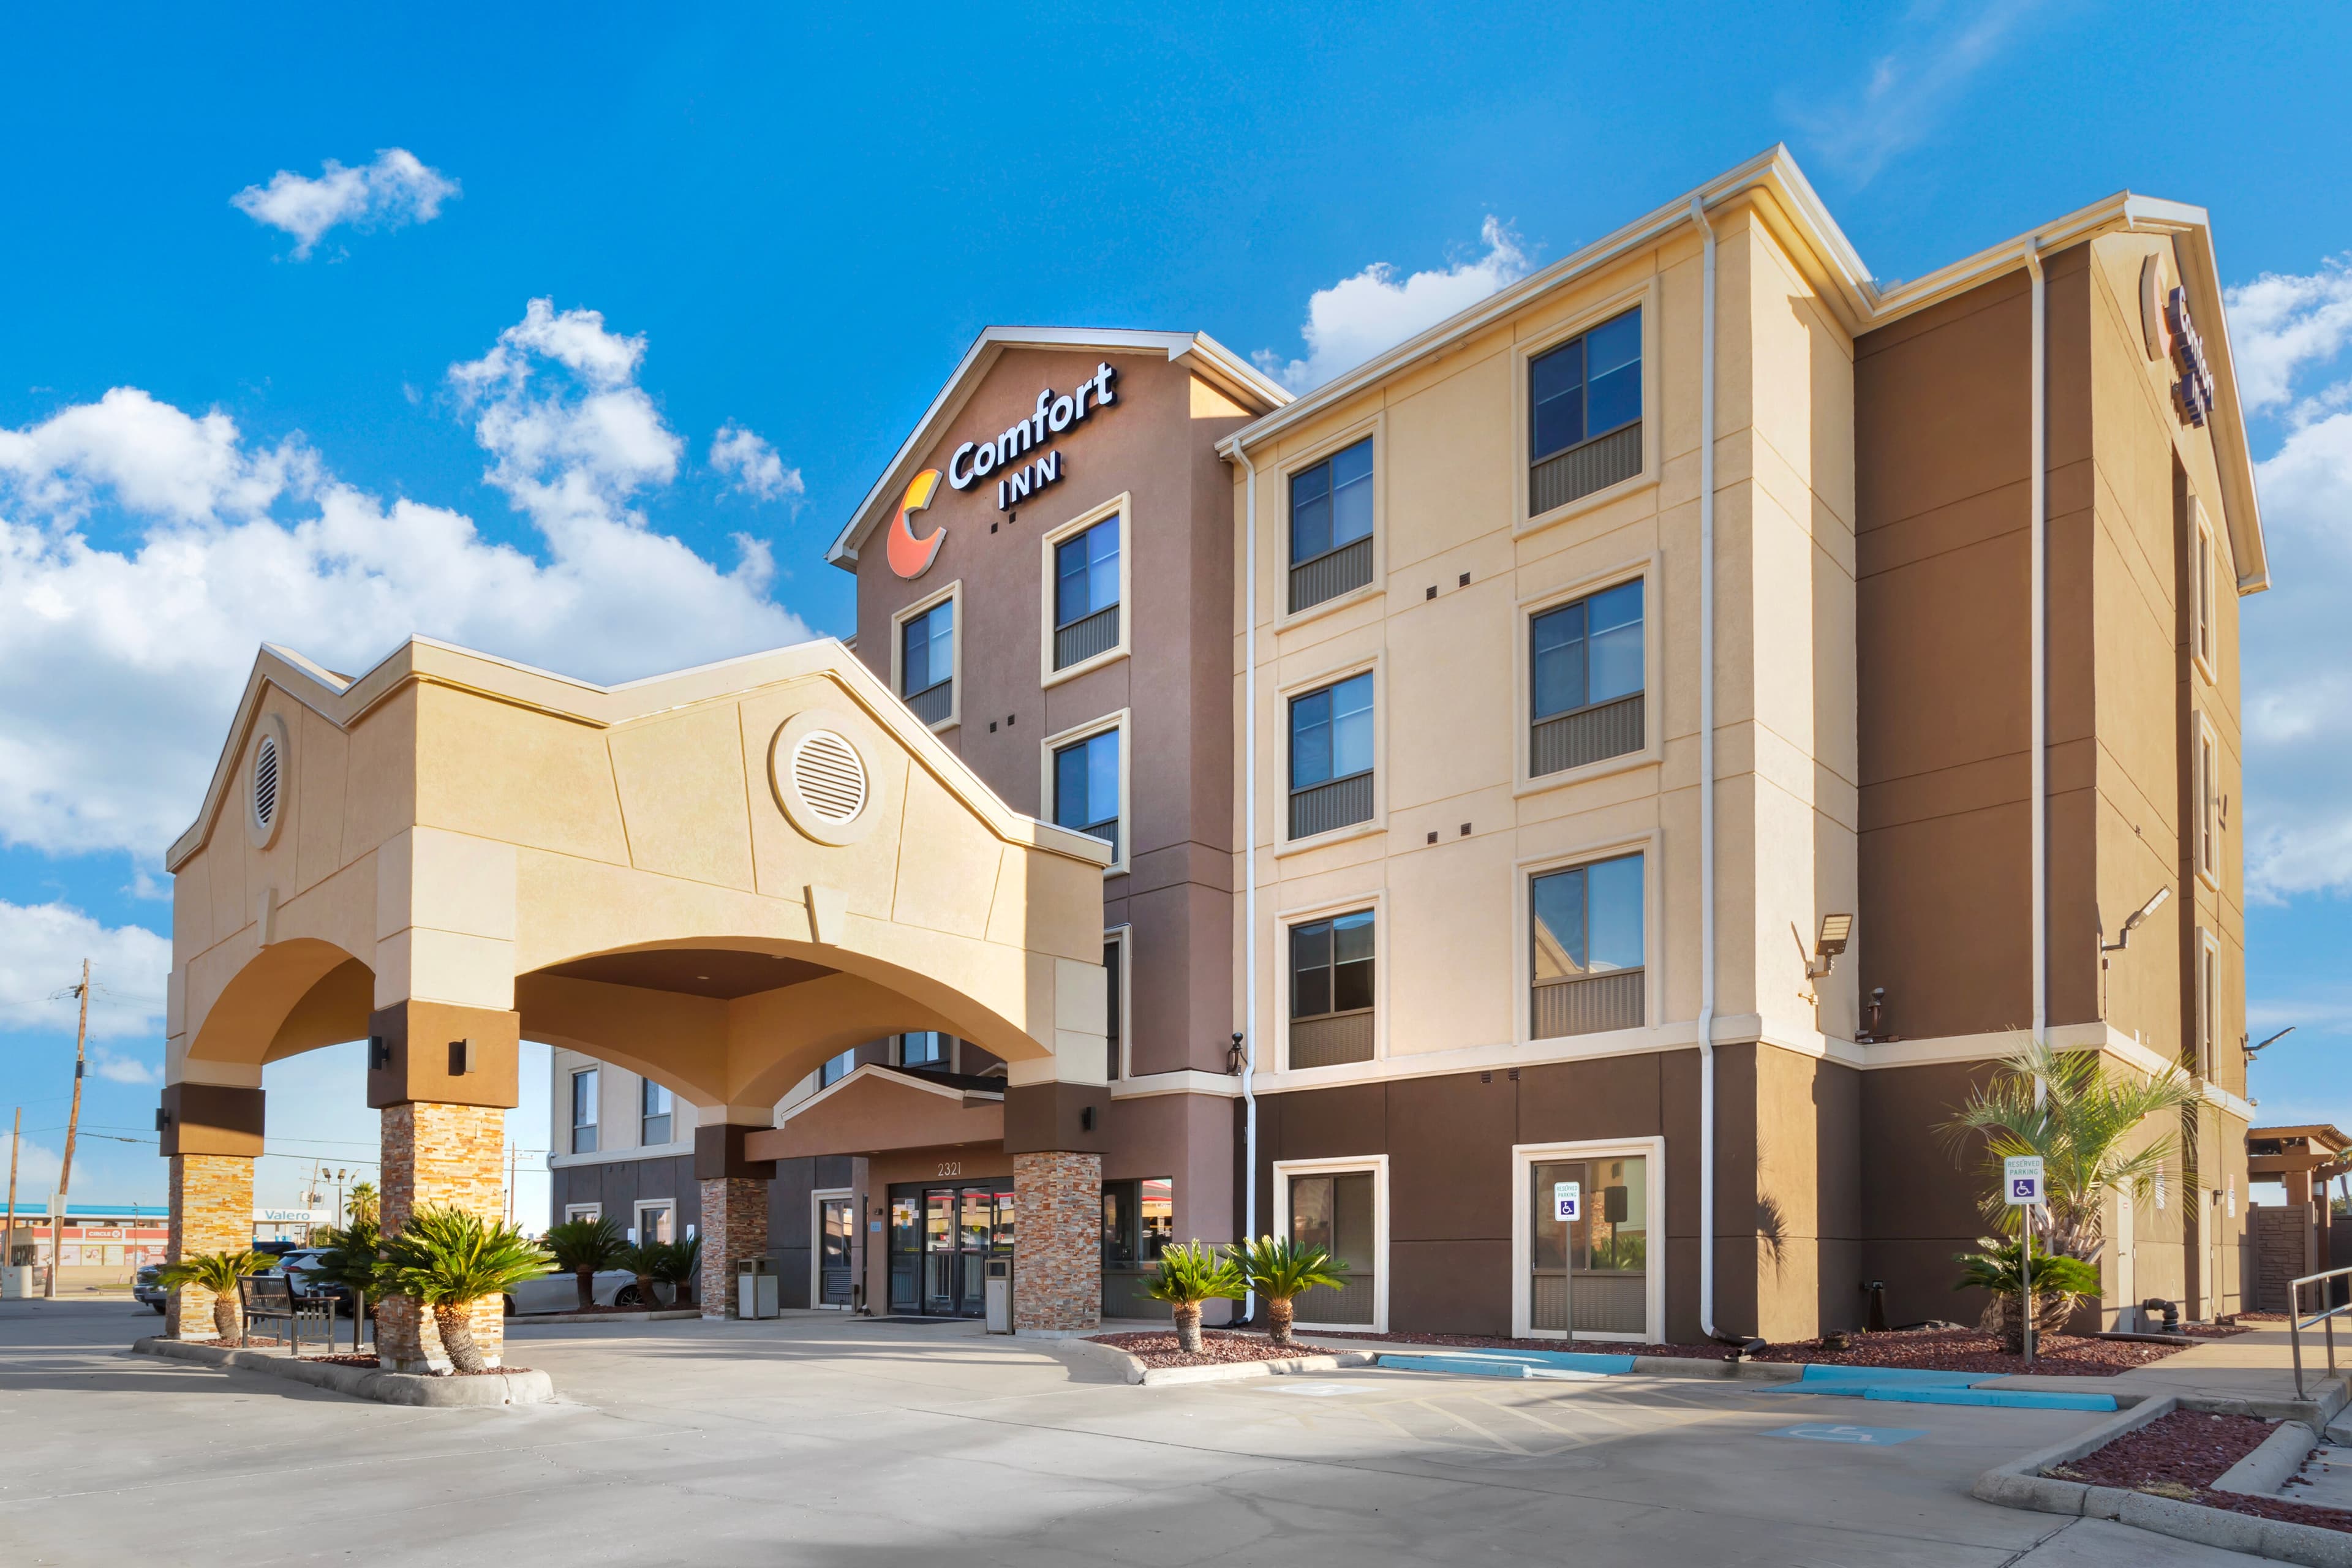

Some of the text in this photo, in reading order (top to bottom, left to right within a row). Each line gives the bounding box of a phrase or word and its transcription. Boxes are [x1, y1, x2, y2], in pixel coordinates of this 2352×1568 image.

[948, 361, 1118, 491] Comfort
[998, 450, 1061, 511] INN
[938, 1161, 961, 1176] 2321
[265, 1210, 311, 1220] Valero
